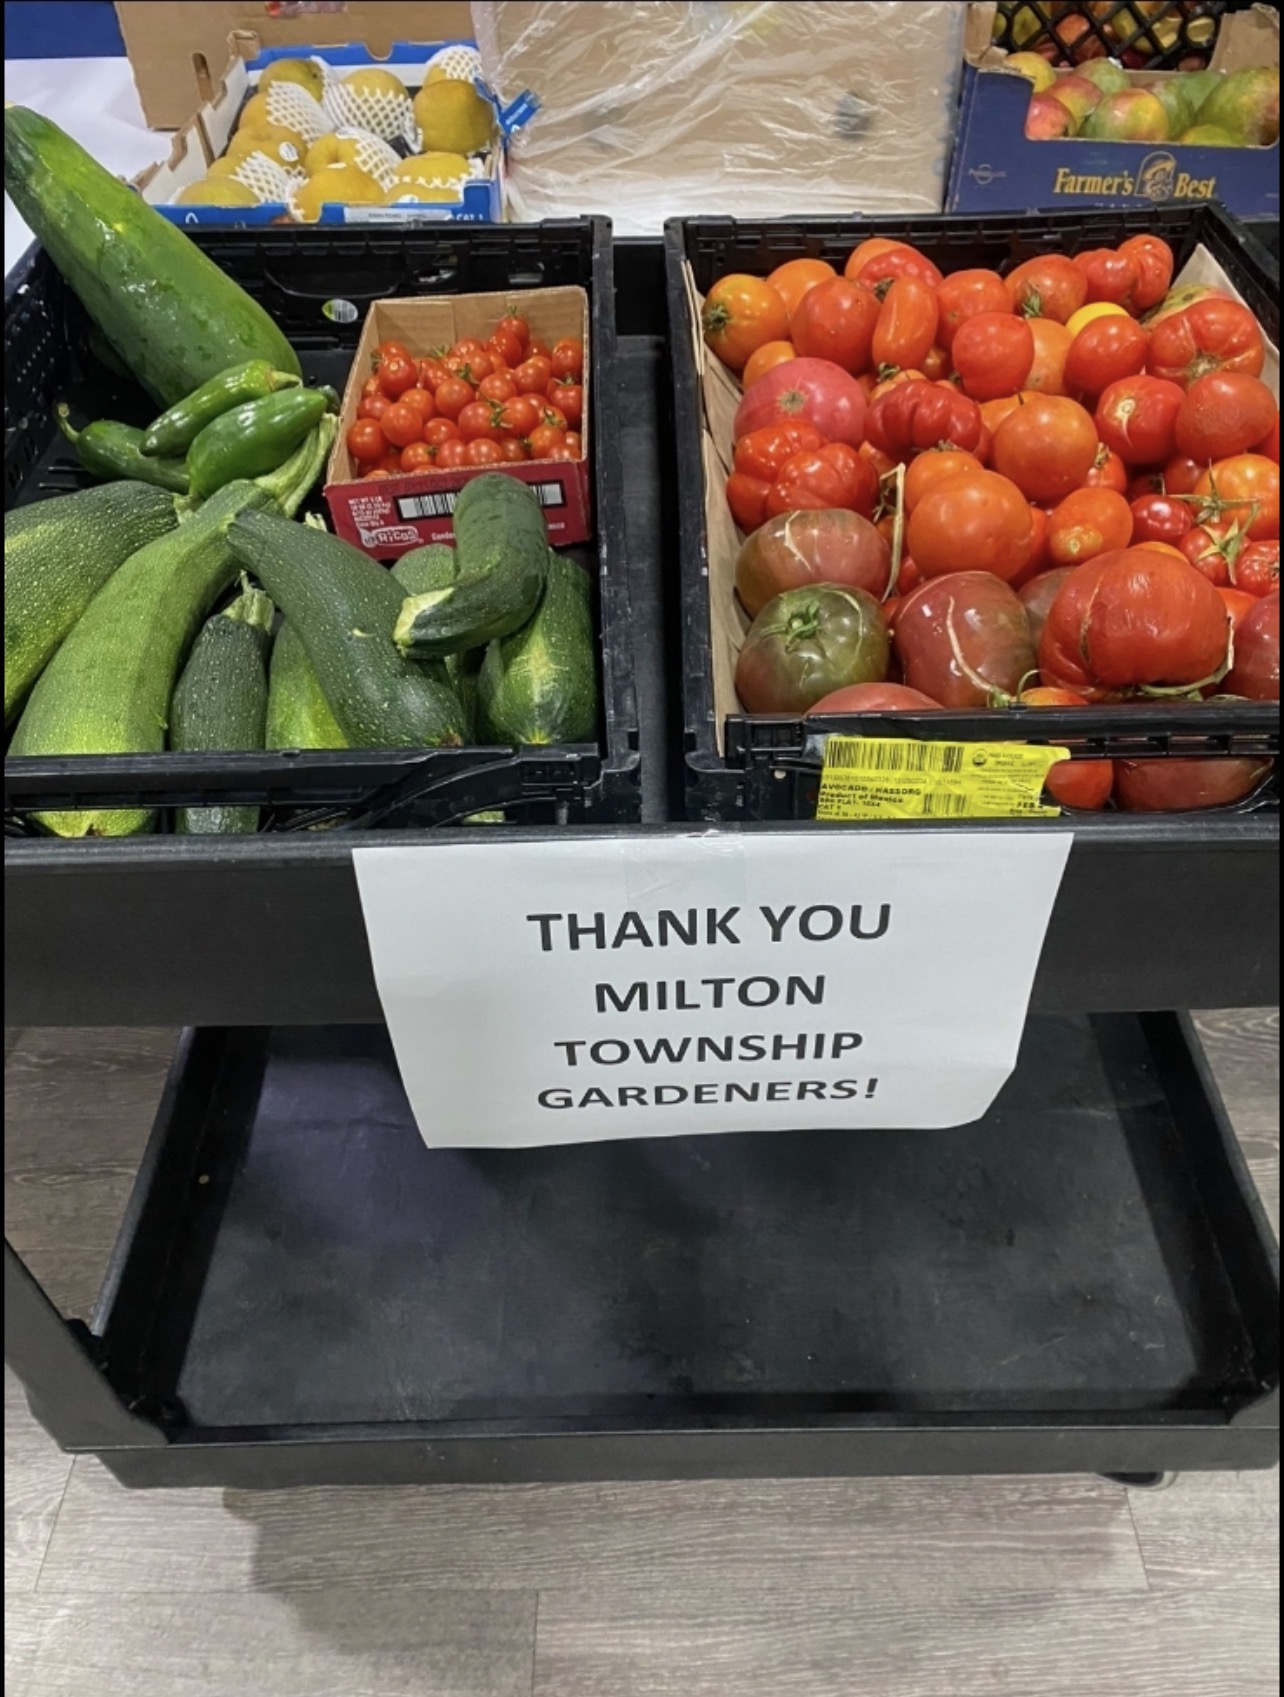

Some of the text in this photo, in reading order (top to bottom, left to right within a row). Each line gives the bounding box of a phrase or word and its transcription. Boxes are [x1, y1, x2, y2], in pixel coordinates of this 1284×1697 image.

[1053, 167, 1217, 198] Farmer's Best
[820, 791, 856, 799] Product
[870, 793, 903, 803] Mexico
[821, 783, 868, 792] AVOCADO
[527, 904, 891, 951] THANK YOU
[596, 976, 825, 1012] MILTON
[554, 1033, 863, 1065] TOWNSHIP
[538, 1079, 878, 1109] GARDENERS!
